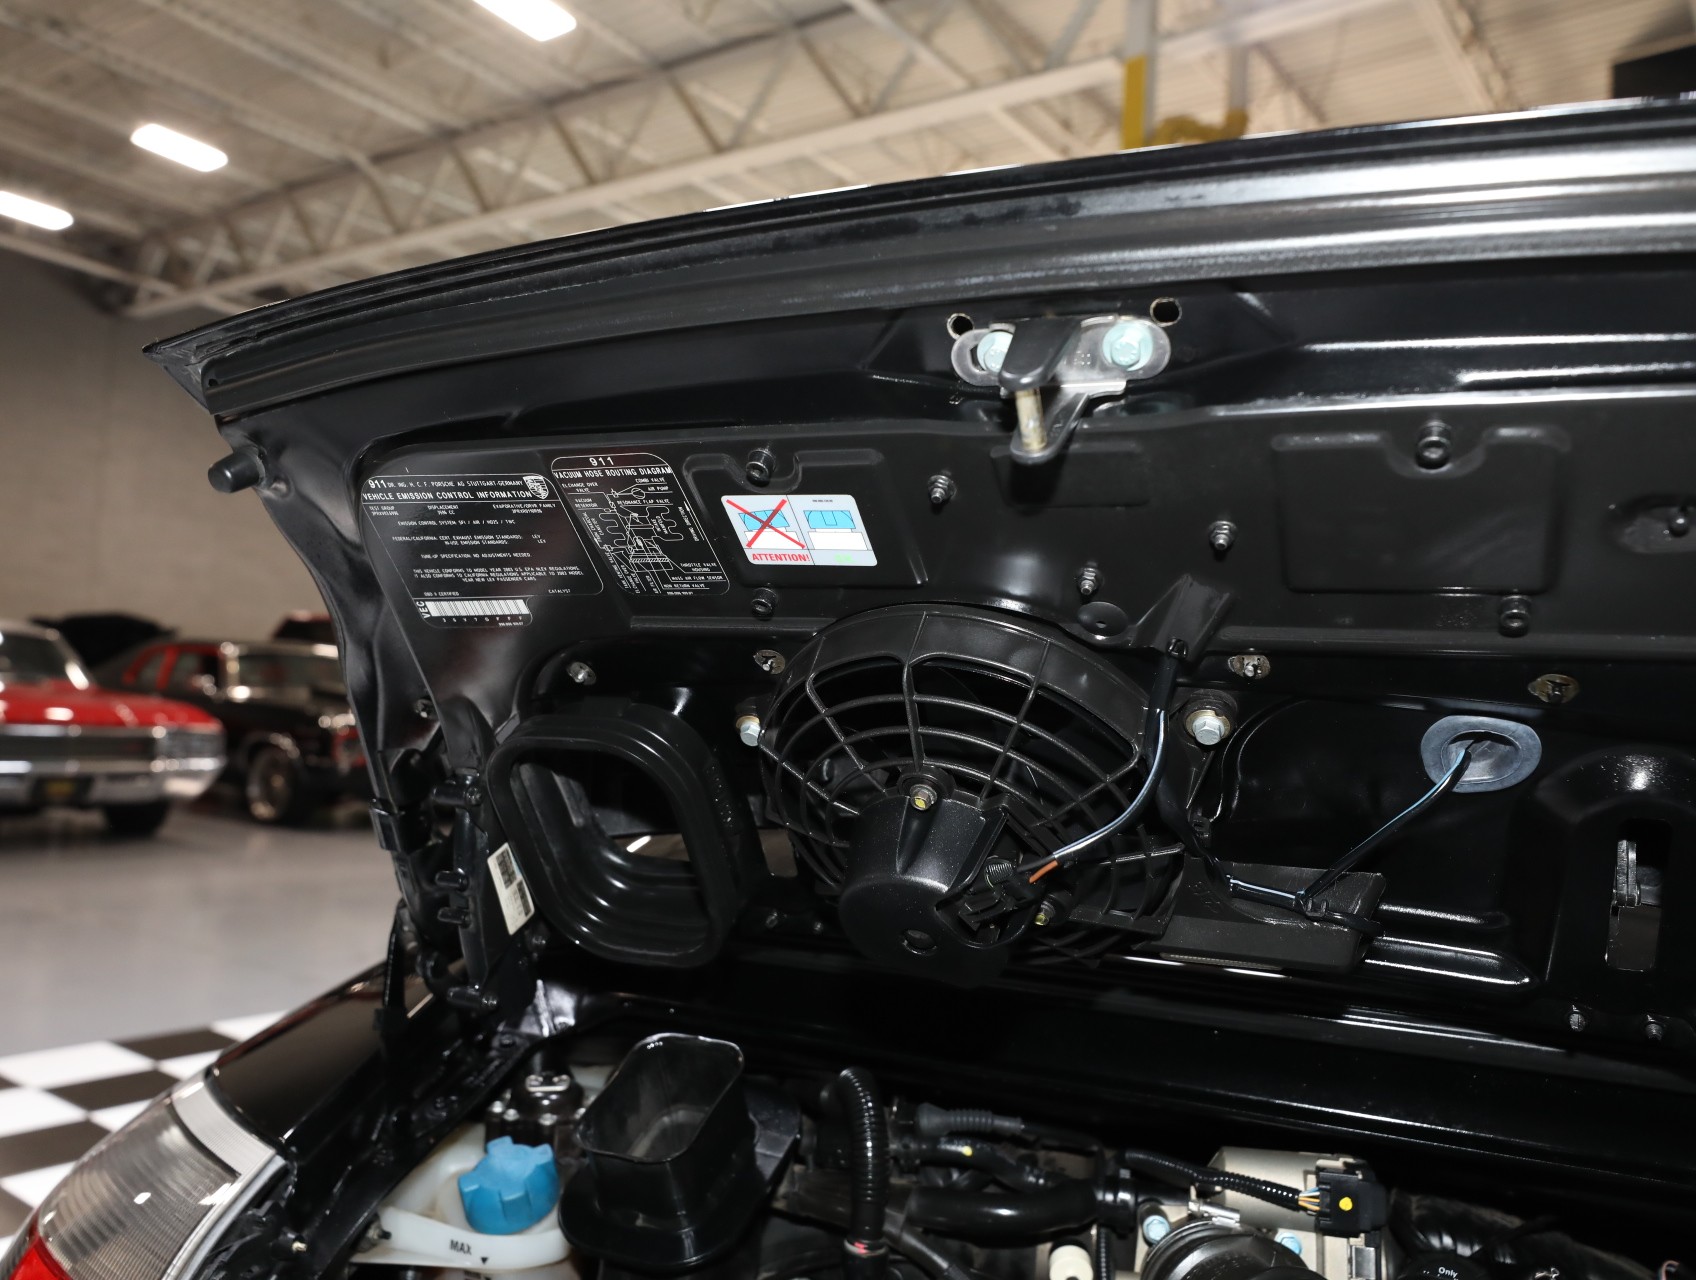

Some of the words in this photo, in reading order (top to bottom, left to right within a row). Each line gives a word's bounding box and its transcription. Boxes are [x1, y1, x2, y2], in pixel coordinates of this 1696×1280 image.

[589, 457, 614, 466] 911
[554, 471, 583, 479] VACUUM
[584, 469, 603, 478] HOSE
[605, 468, 637, 477] ROUTING
[640, 467, 673, 475] DIAGRAM
[368, 480, 387, 488] 911
[363, 493, 394, 501] VEHICLE
[476, 490, 533, 498] INFORMATION
[752, 553, 810, 562] ATTENTION!
[415, 600, 431, 619] VEC
[449, 1239, 472, 1255] MAX
[1438, 1266, 1458, 1278] Only
